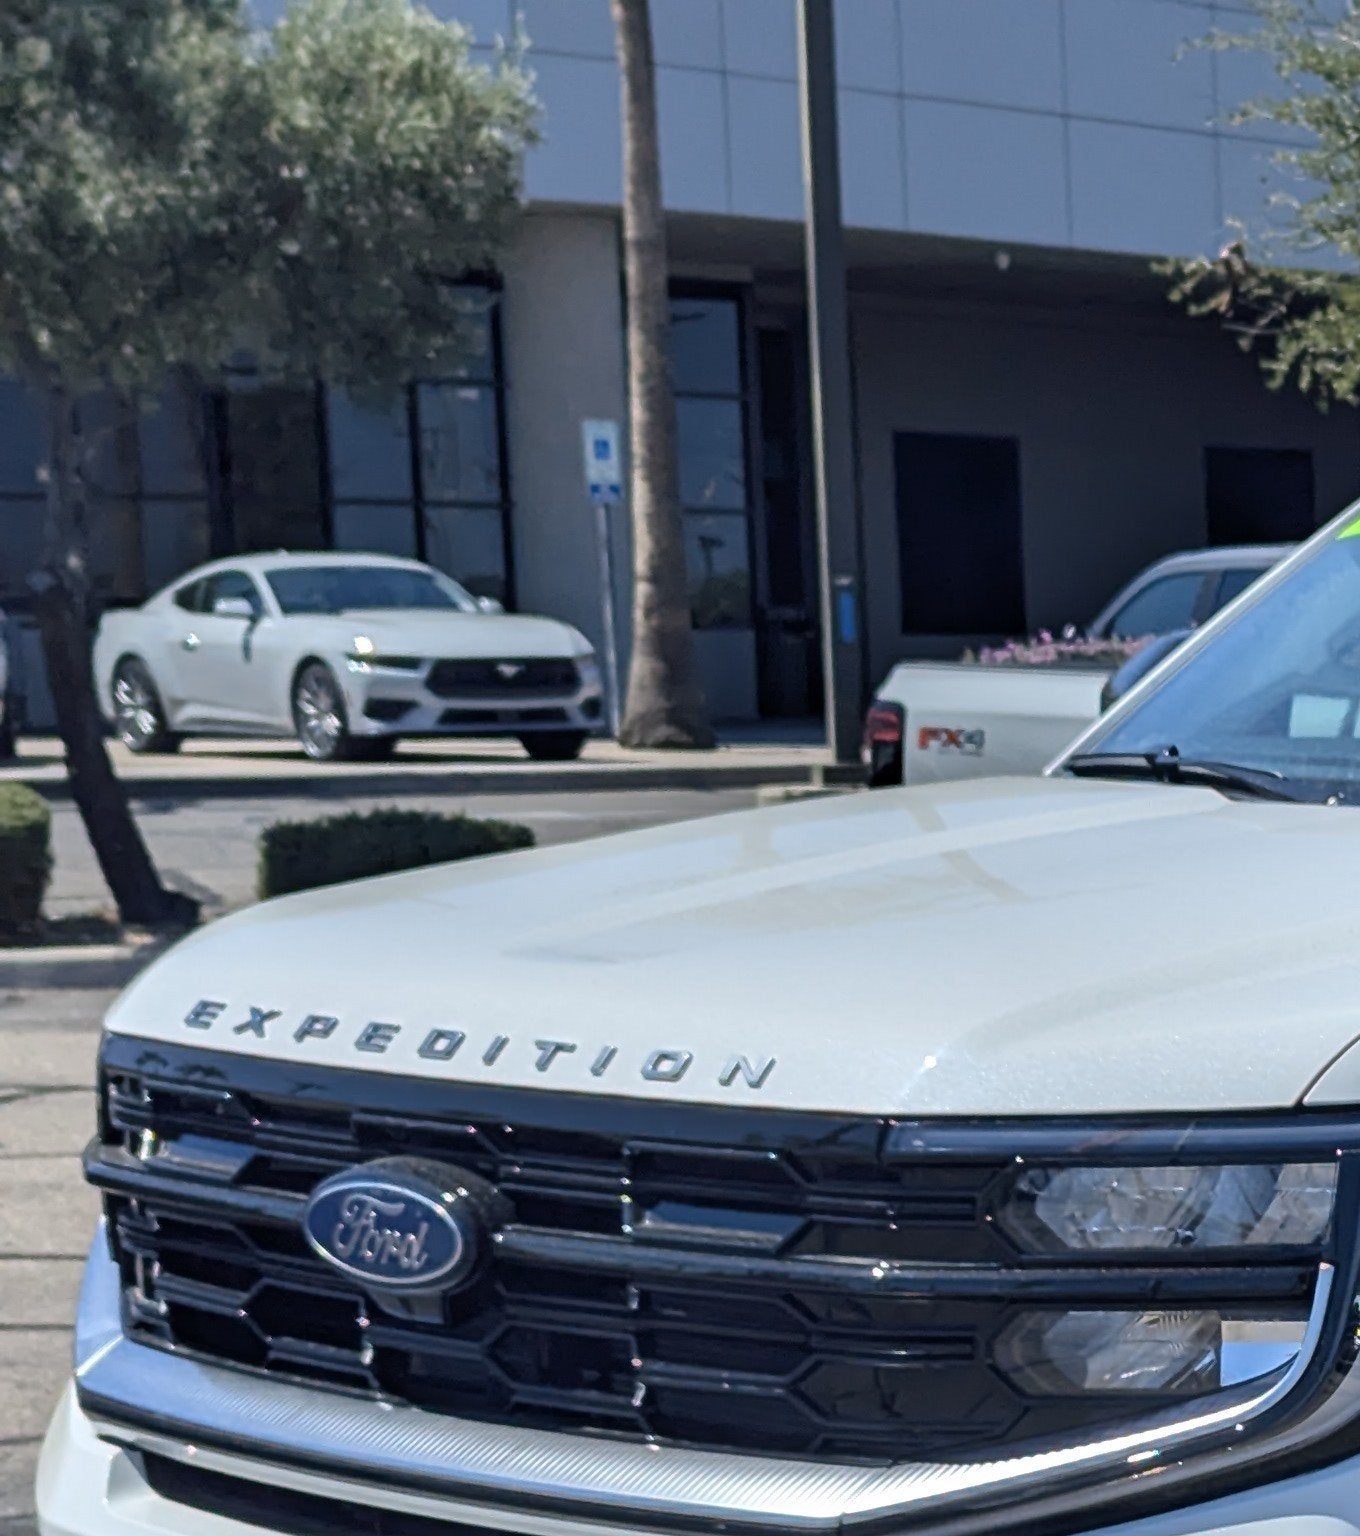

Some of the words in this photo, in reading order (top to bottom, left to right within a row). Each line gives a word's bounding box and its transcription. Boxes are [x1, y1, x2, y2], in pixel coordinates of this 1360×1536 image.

[918, 727, 986, 757] FX4
[184, 999, 777, 1090] EXPEDITION
[332, 1192, 430, 1271] Ford
